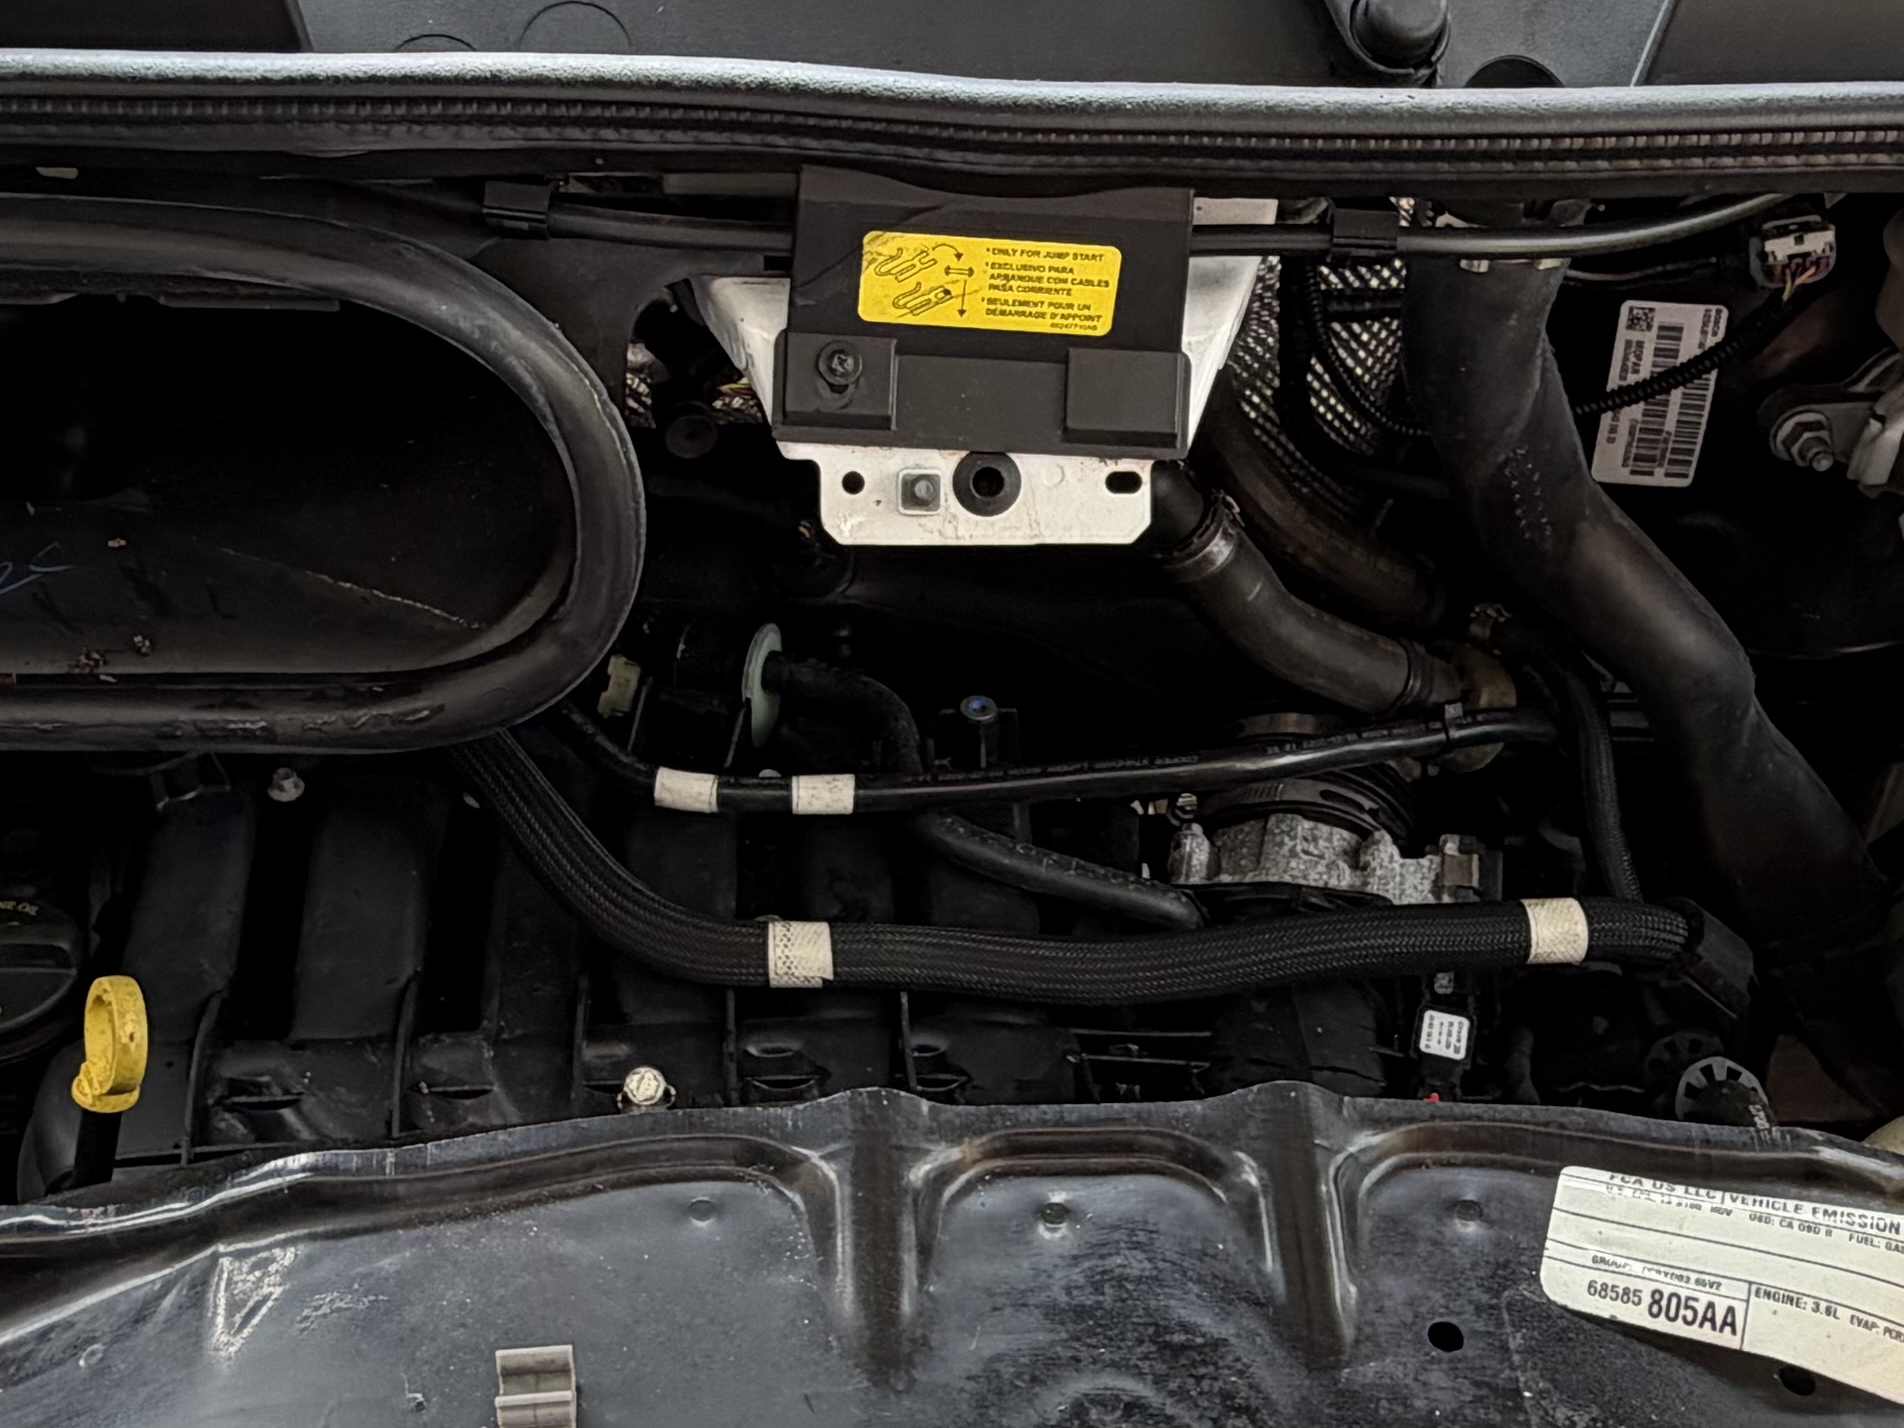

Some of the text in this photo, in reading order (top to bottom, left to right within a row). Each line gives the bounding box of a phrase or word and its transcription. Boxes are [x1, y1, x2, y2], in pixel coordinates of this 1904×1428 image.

[1020, 250, 1041, 258] FOR
[1043, 251, 1070, 260] JUMP
[1072, 253, 1105, 262] START
[1609, 1172, 1644, 1188] FCA
[1652, 1180, 1676, 1193] US
[1683, 1185, 1718, 1201] LLC
[1729, 1192, 1805, 1216] VEHICLE
[1811, 1205, 1901, 1235] EMISSION
[1778, 1218, 1795, 1232] CA
[1848, 1233, 1881, 1249] FUEL:
[1586, 1278, 1739, 1336] 68585 805AA
[1753, 1286, 1809, 1312] ENGINE:
[1811, 1300, 1841, 1321] 3.6L
[1849, 1313, 1880, 1333] EVAP:
